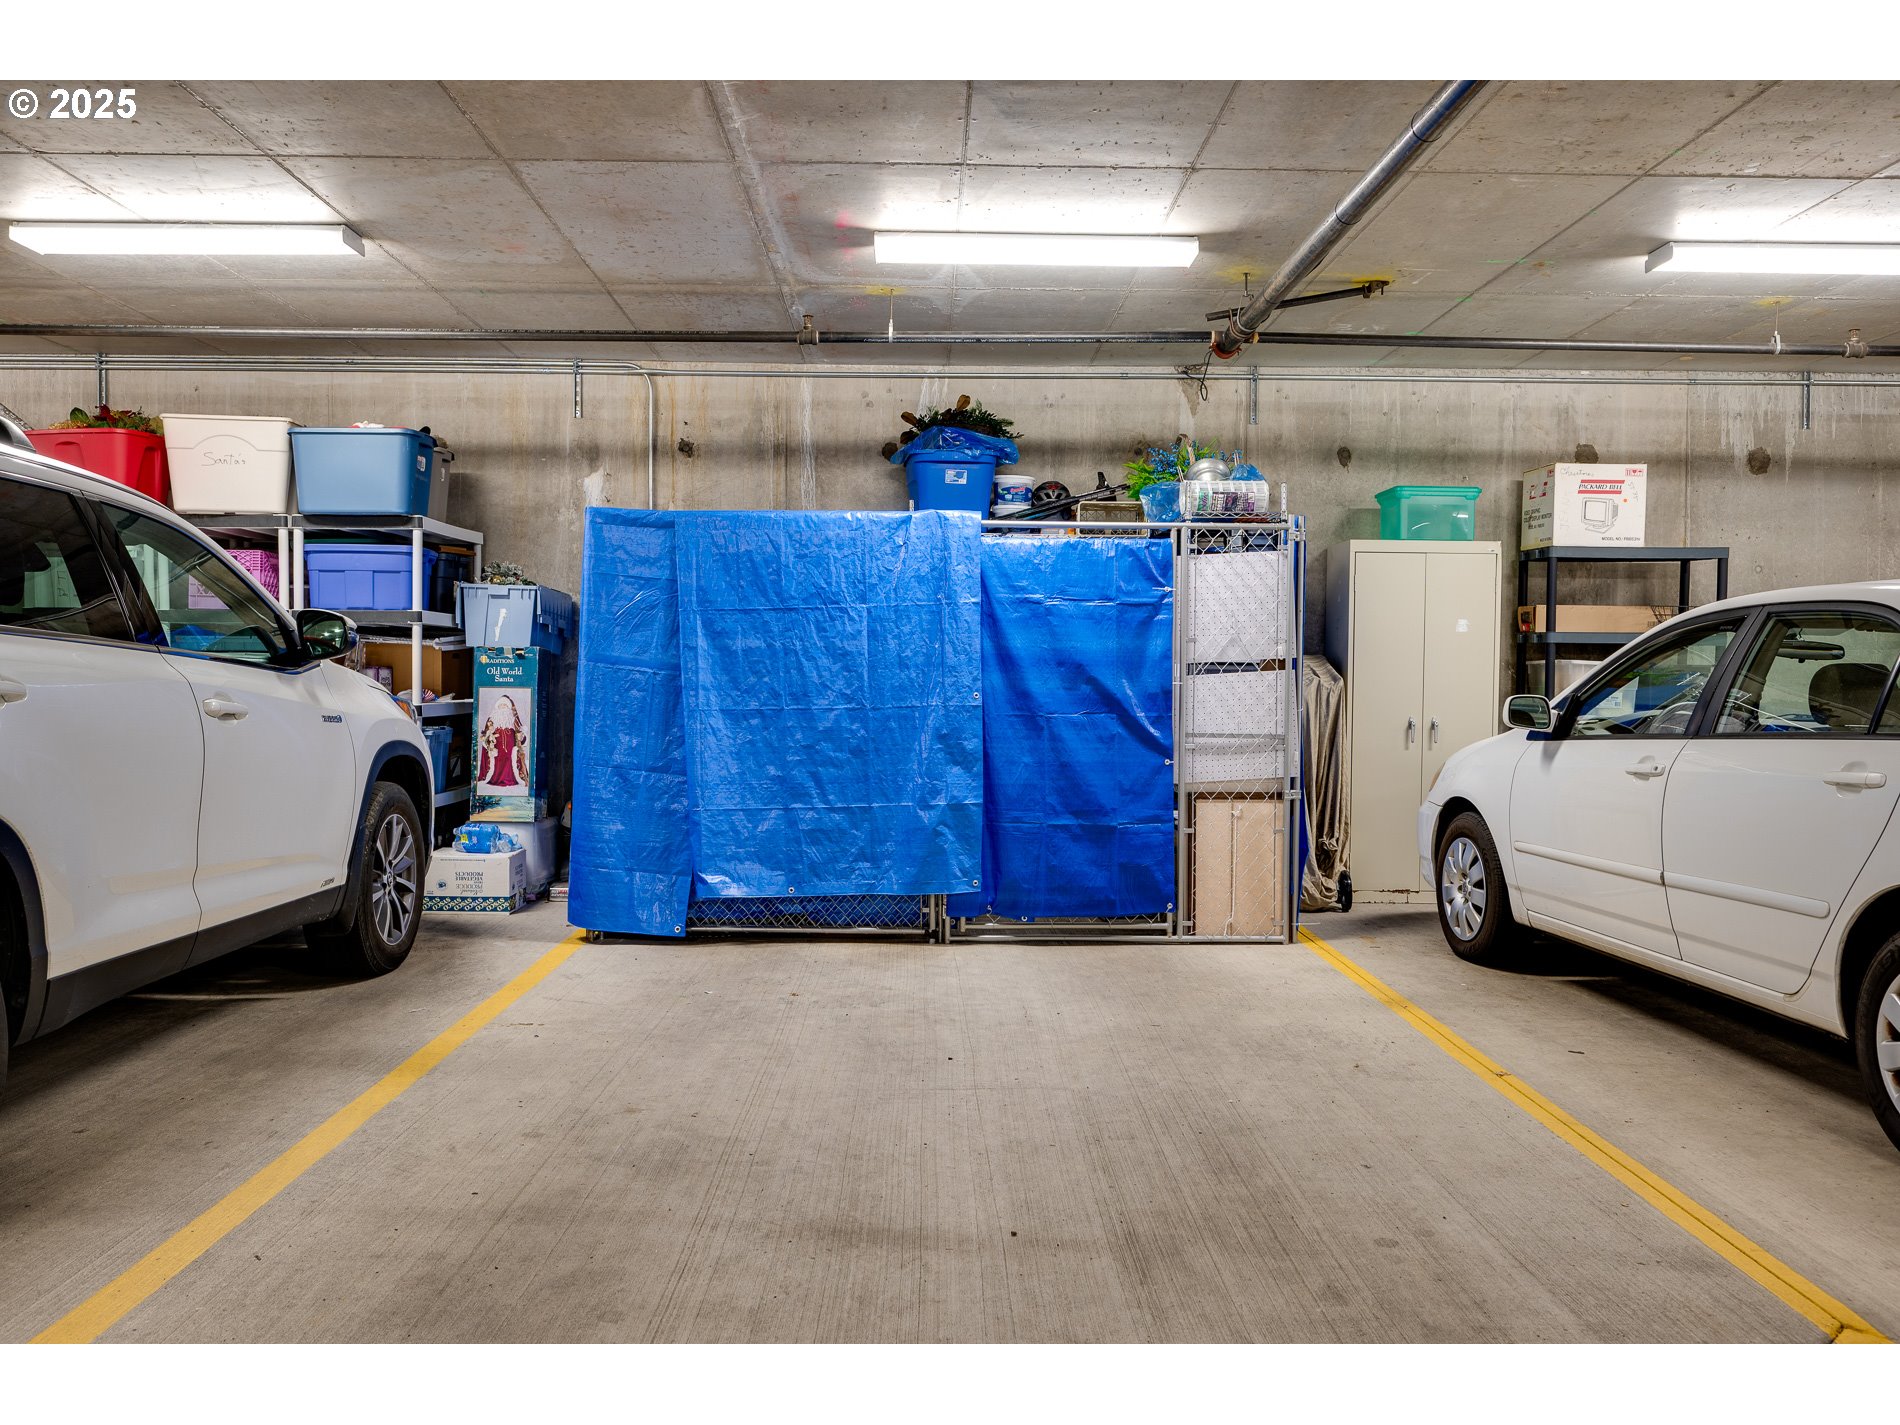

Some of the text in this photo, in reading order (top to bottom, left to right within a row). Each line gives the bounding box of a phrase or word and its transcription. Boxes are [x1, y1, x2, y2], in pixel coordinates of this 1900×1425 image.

[486, 666, 523, 675] Old World
[494, 674, 514, 682] Santa
